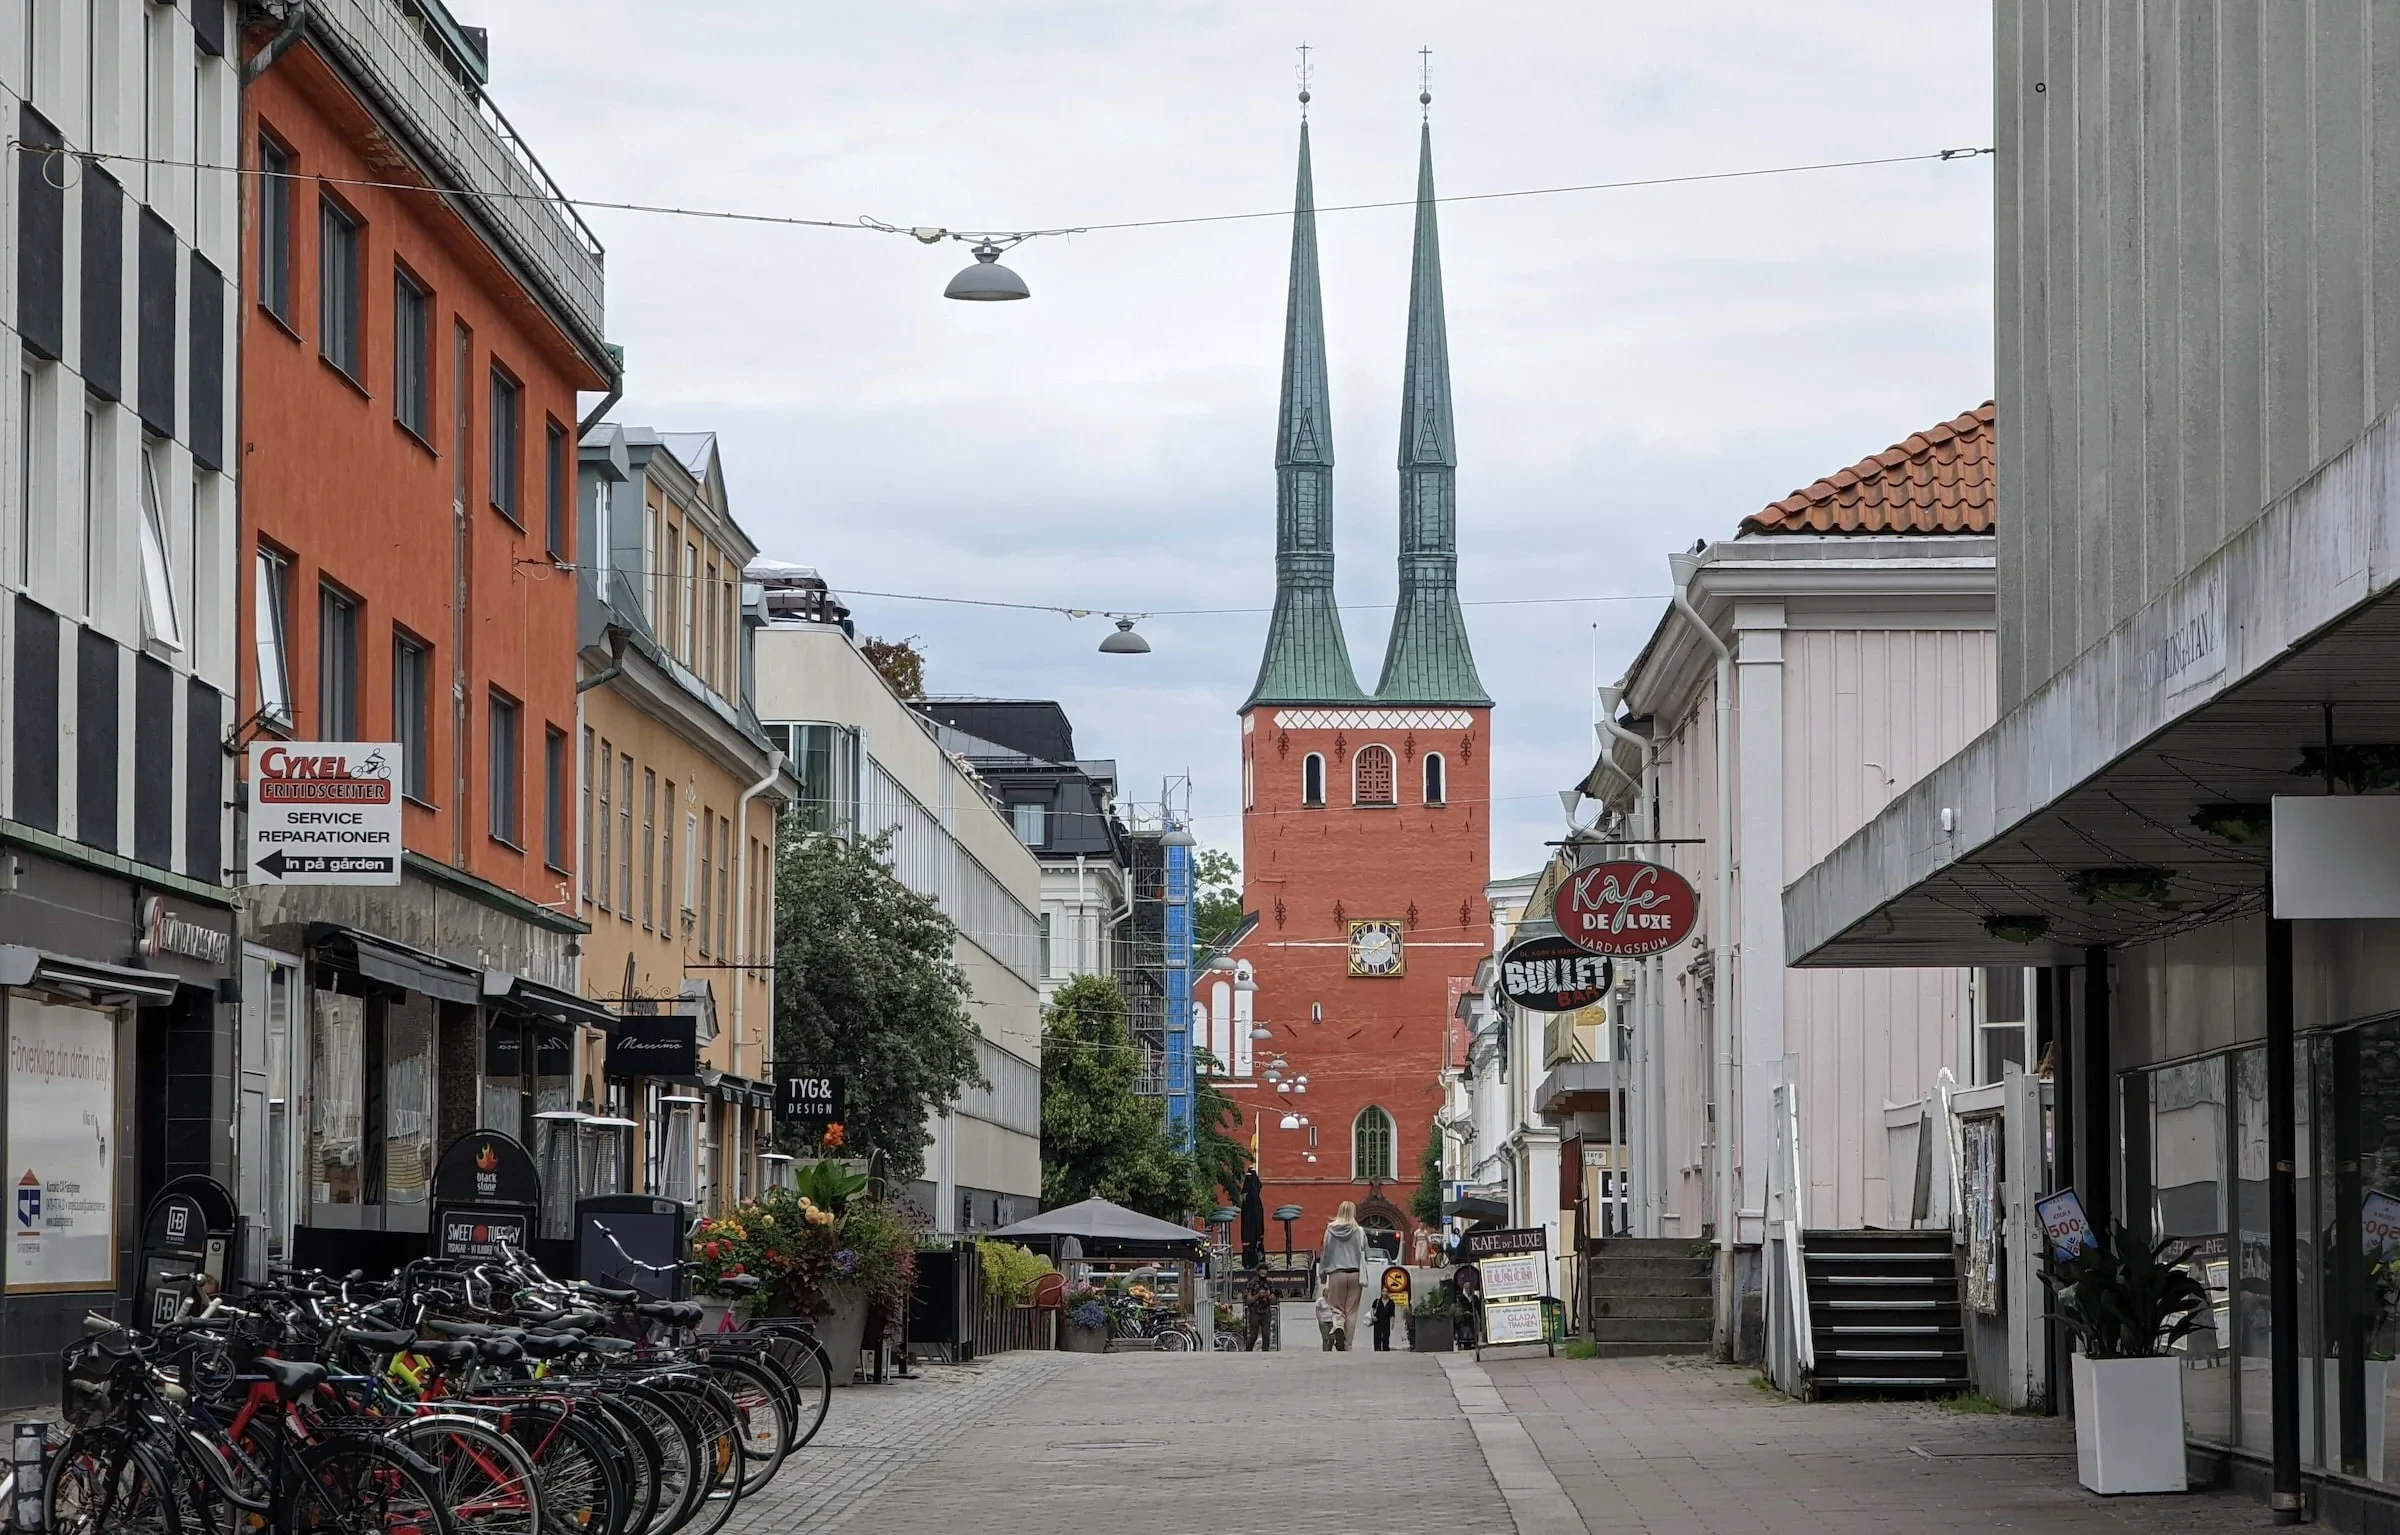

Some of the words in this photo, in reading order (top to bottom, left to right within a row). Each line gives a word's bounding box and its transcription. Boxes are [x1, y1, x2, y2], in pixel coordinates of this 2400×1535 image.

[260, 747, 351, 779] CYKEL
[264, 783, 386, 799] FRITIDSCENTER
[287, 812, 363, 824] SERVICE
[258, 831, 390, 843] REPARATIONER
[285, 858, 300, 870] In
[305, 857, 325, 872] på
[330, 857, 385, 872] gården
[1582, 913, 1610, 930] DE
[1626, 913, 1672, 930] LUXE
[1580, 934, 1669, 955] VARDAGSRUM
[1504, 955, 1608, 996] BULLET
[1557, 985, 1600, 1008] BAR
[616, 1036, 683, 1051] Massimo
[11, 1035, 55, 1085] Förverkliga
[56, 1041, 68, 1077] din
[70, 1043, 90, 1080] dröm
[789, 1078, 832, 1098] TYG&
[788, 1103, 832, 1115] DESIGN
[476, 1171, 497, 1183] black
[476, 1181, 497, 1192] stone
[448, 1223, 475, 1242] SWEET
[488, 1226, 521, 1244] TUESAY
